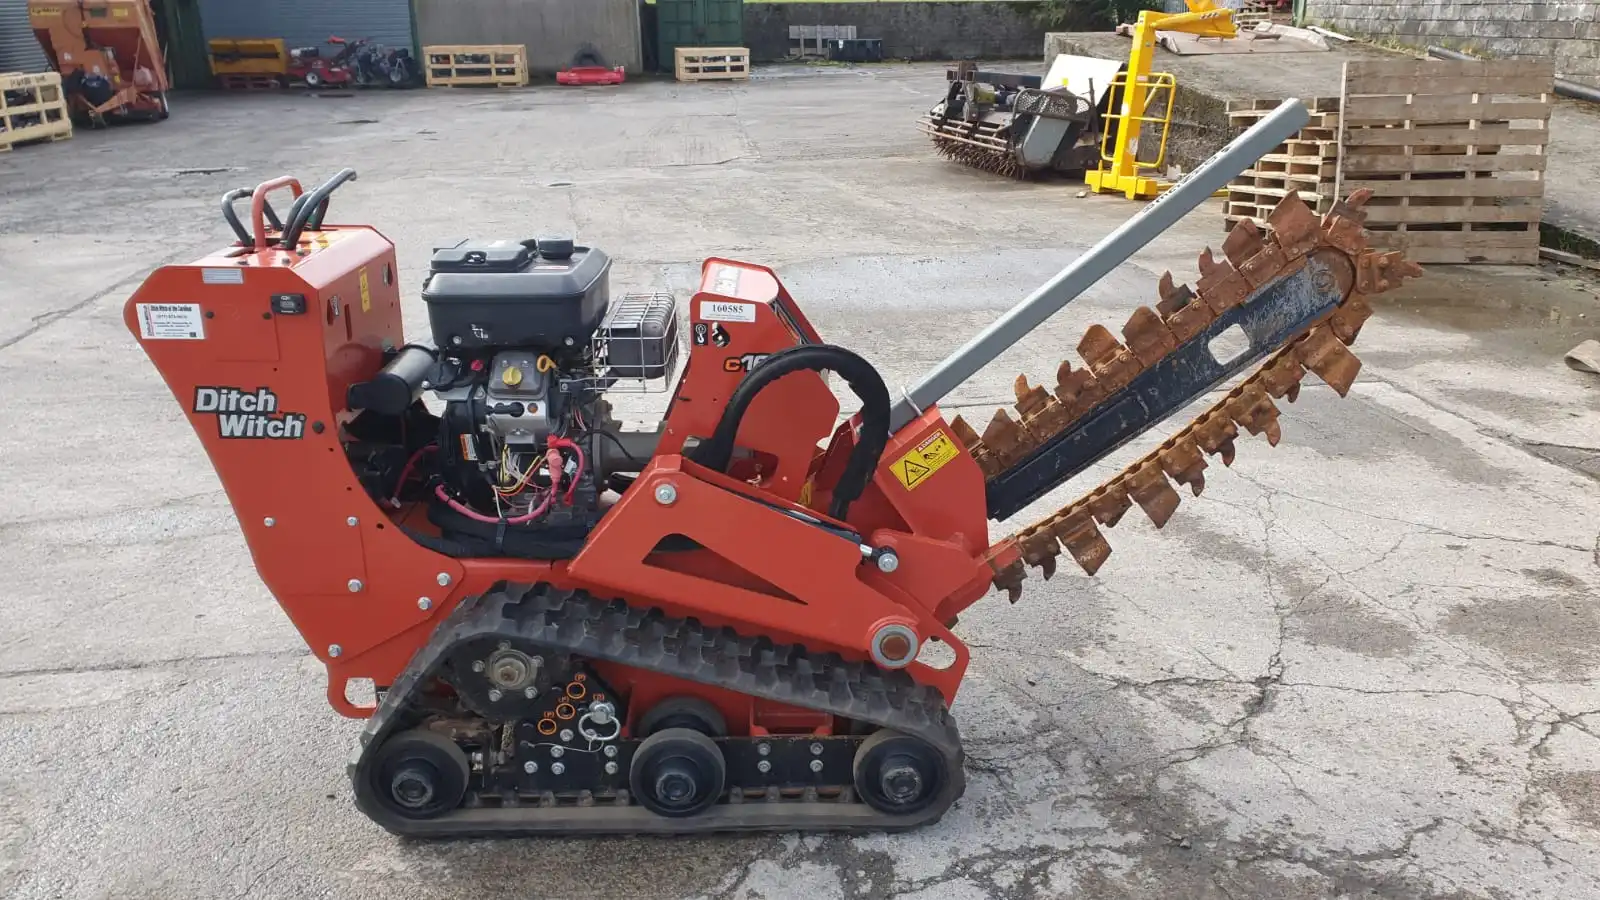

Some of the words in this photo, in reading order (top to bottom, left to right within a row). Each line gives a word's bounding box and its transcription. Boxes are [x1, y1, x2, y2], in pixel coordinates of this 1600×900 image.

[712, 304, 744, 313] 160585
[195, 387, 276, 412] Ditch
[219, 414, 302, 438] Witch
